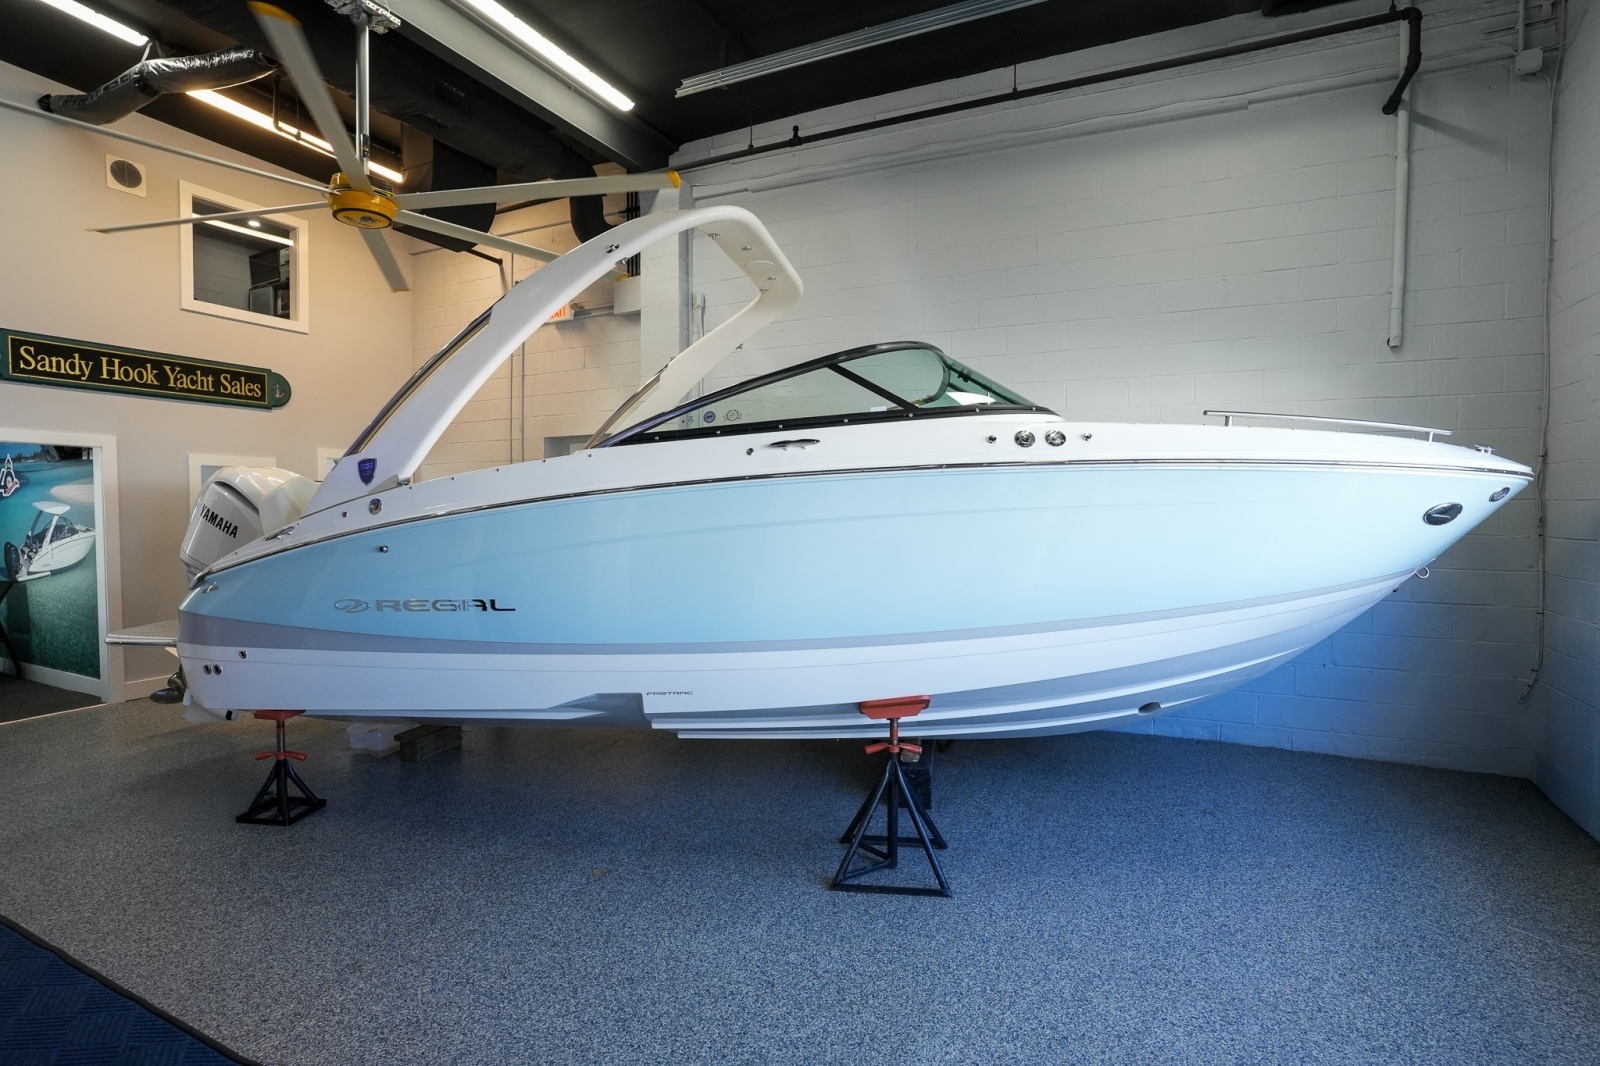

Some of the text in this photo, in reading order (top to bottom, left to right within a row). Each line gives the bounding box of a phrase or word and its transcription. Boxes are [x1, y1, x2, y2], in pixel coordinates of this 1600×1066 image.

[20, 345, 262, 398] Sandy Hook Yacht Sales
[200, 503, 238, 539] YAMAHA
[376, 598, 516, 612] REGAL
